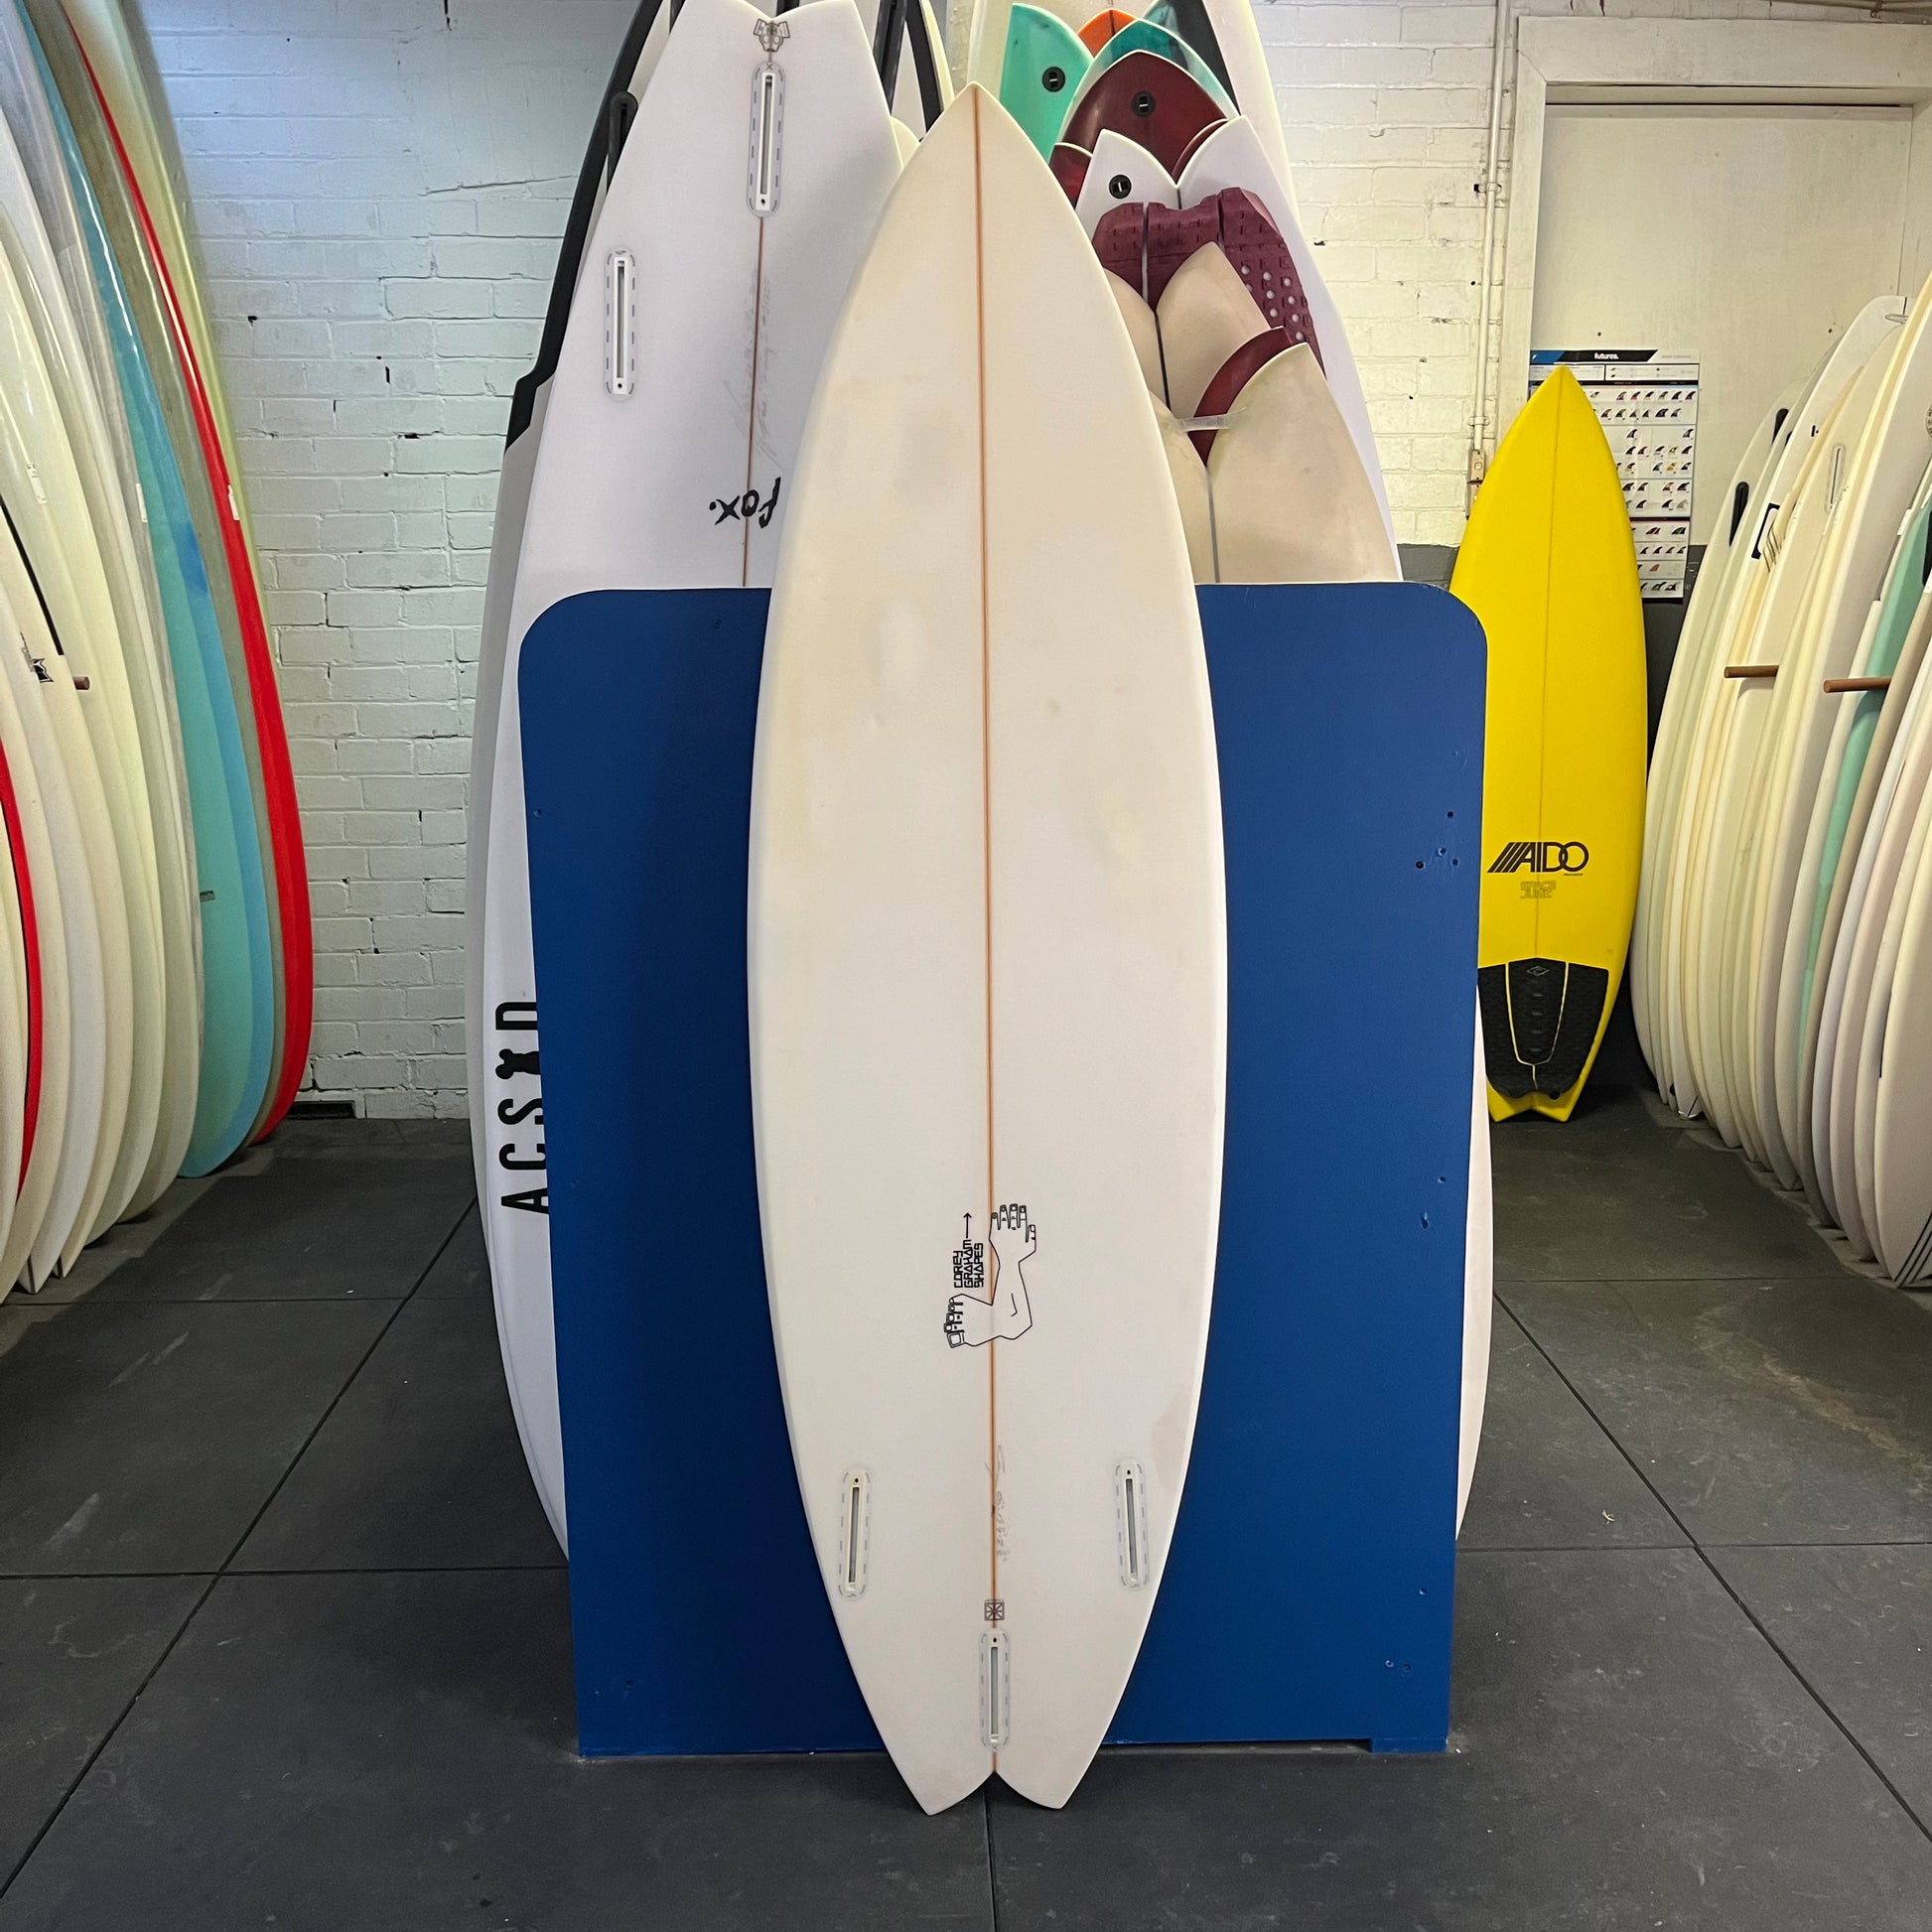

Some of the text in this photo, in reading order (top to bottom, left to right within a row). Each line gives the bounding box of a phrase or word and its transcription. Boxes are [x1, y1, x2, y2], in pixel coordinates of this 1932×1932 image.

[953, 1250, 963, 1288] COREY
[963, 1239, 973, 1288] GRAHAM
[973, 1242, 984, 1288] SHAPES
